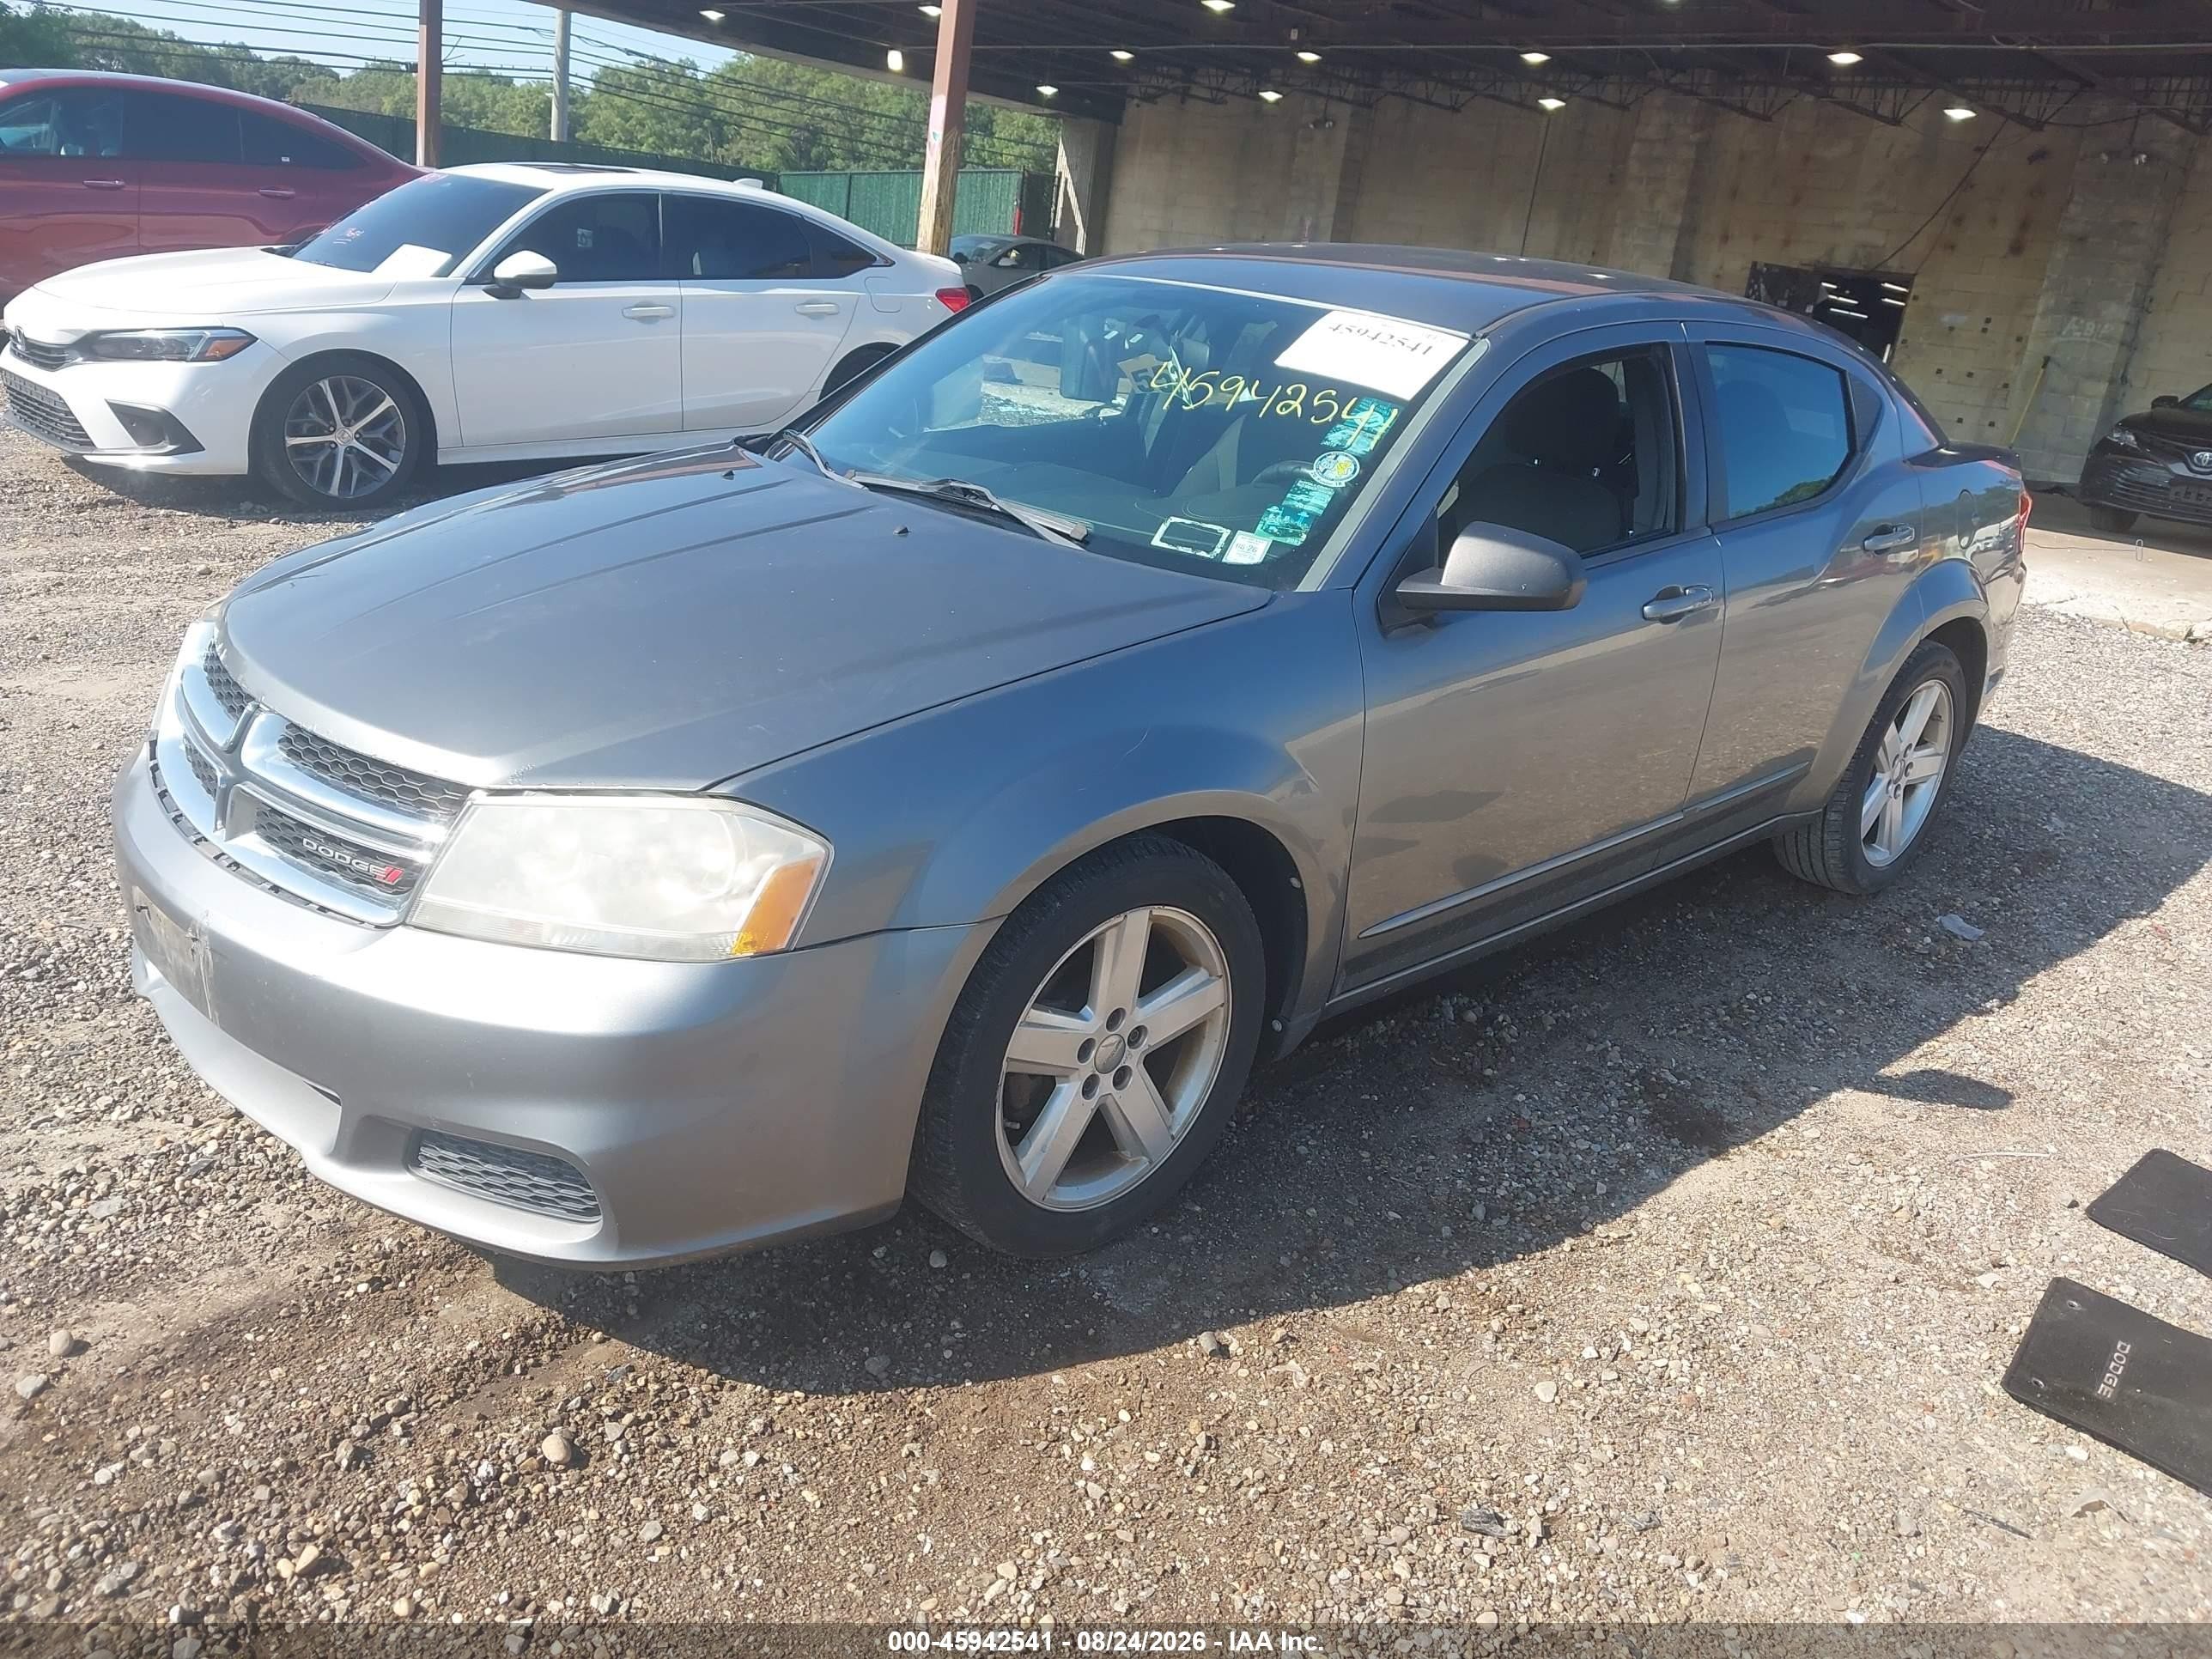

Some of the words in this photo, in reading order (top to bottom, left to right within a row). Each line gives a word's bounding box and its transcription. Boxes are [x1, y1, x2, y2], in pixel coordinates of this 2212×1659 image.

[1328, 323, 1433, 356] 45942541
[1150, 361, 1399, 451] 45942541
[302, 837, 386, 878] DODGE
[2097, 1340, 2131, 1399] DODGE
